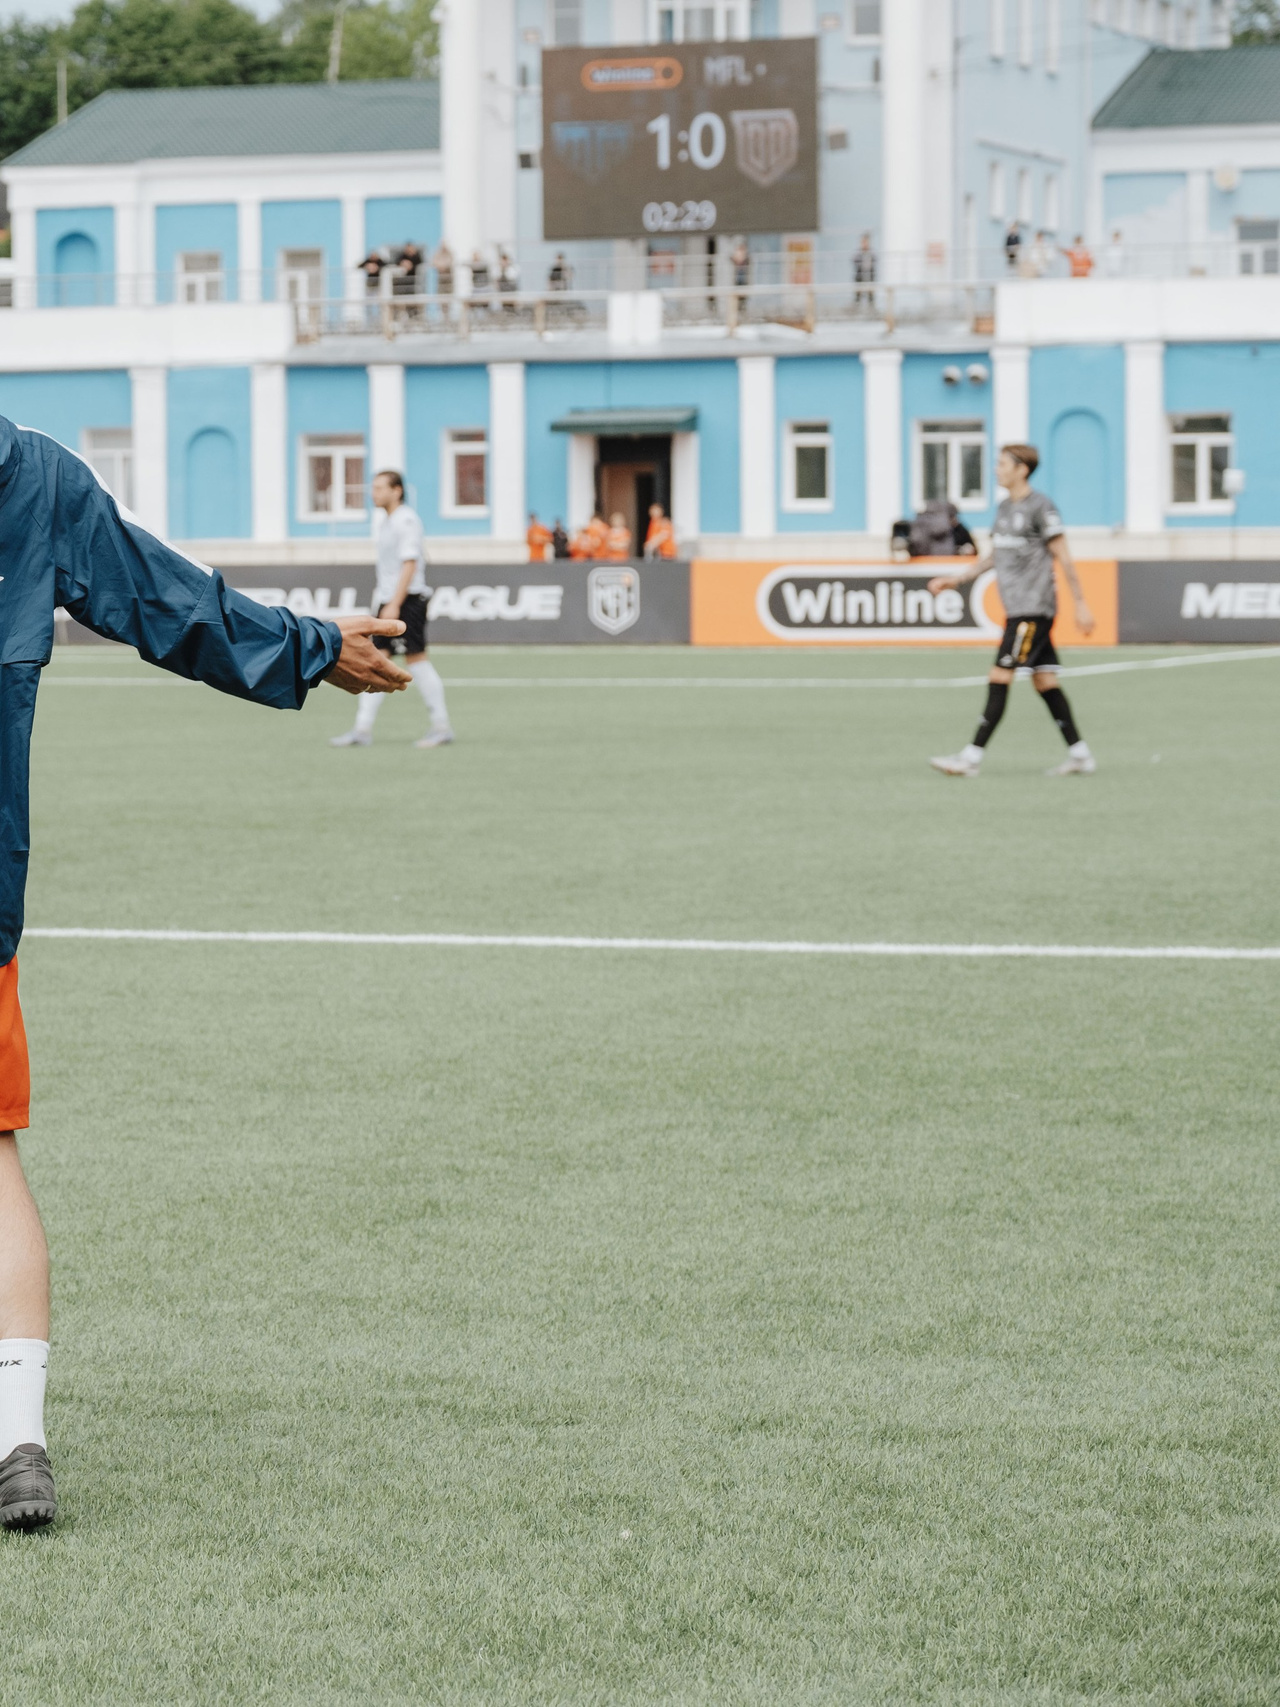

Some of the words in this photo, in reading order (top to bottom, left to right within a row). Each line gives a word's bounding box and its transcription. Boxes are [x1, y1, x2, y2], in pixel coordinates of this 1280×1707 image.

[646, 112, 726, 170] 1:0
[642, 201, 717, 232] 02:29
[781, 580, 965, 624] Winline
